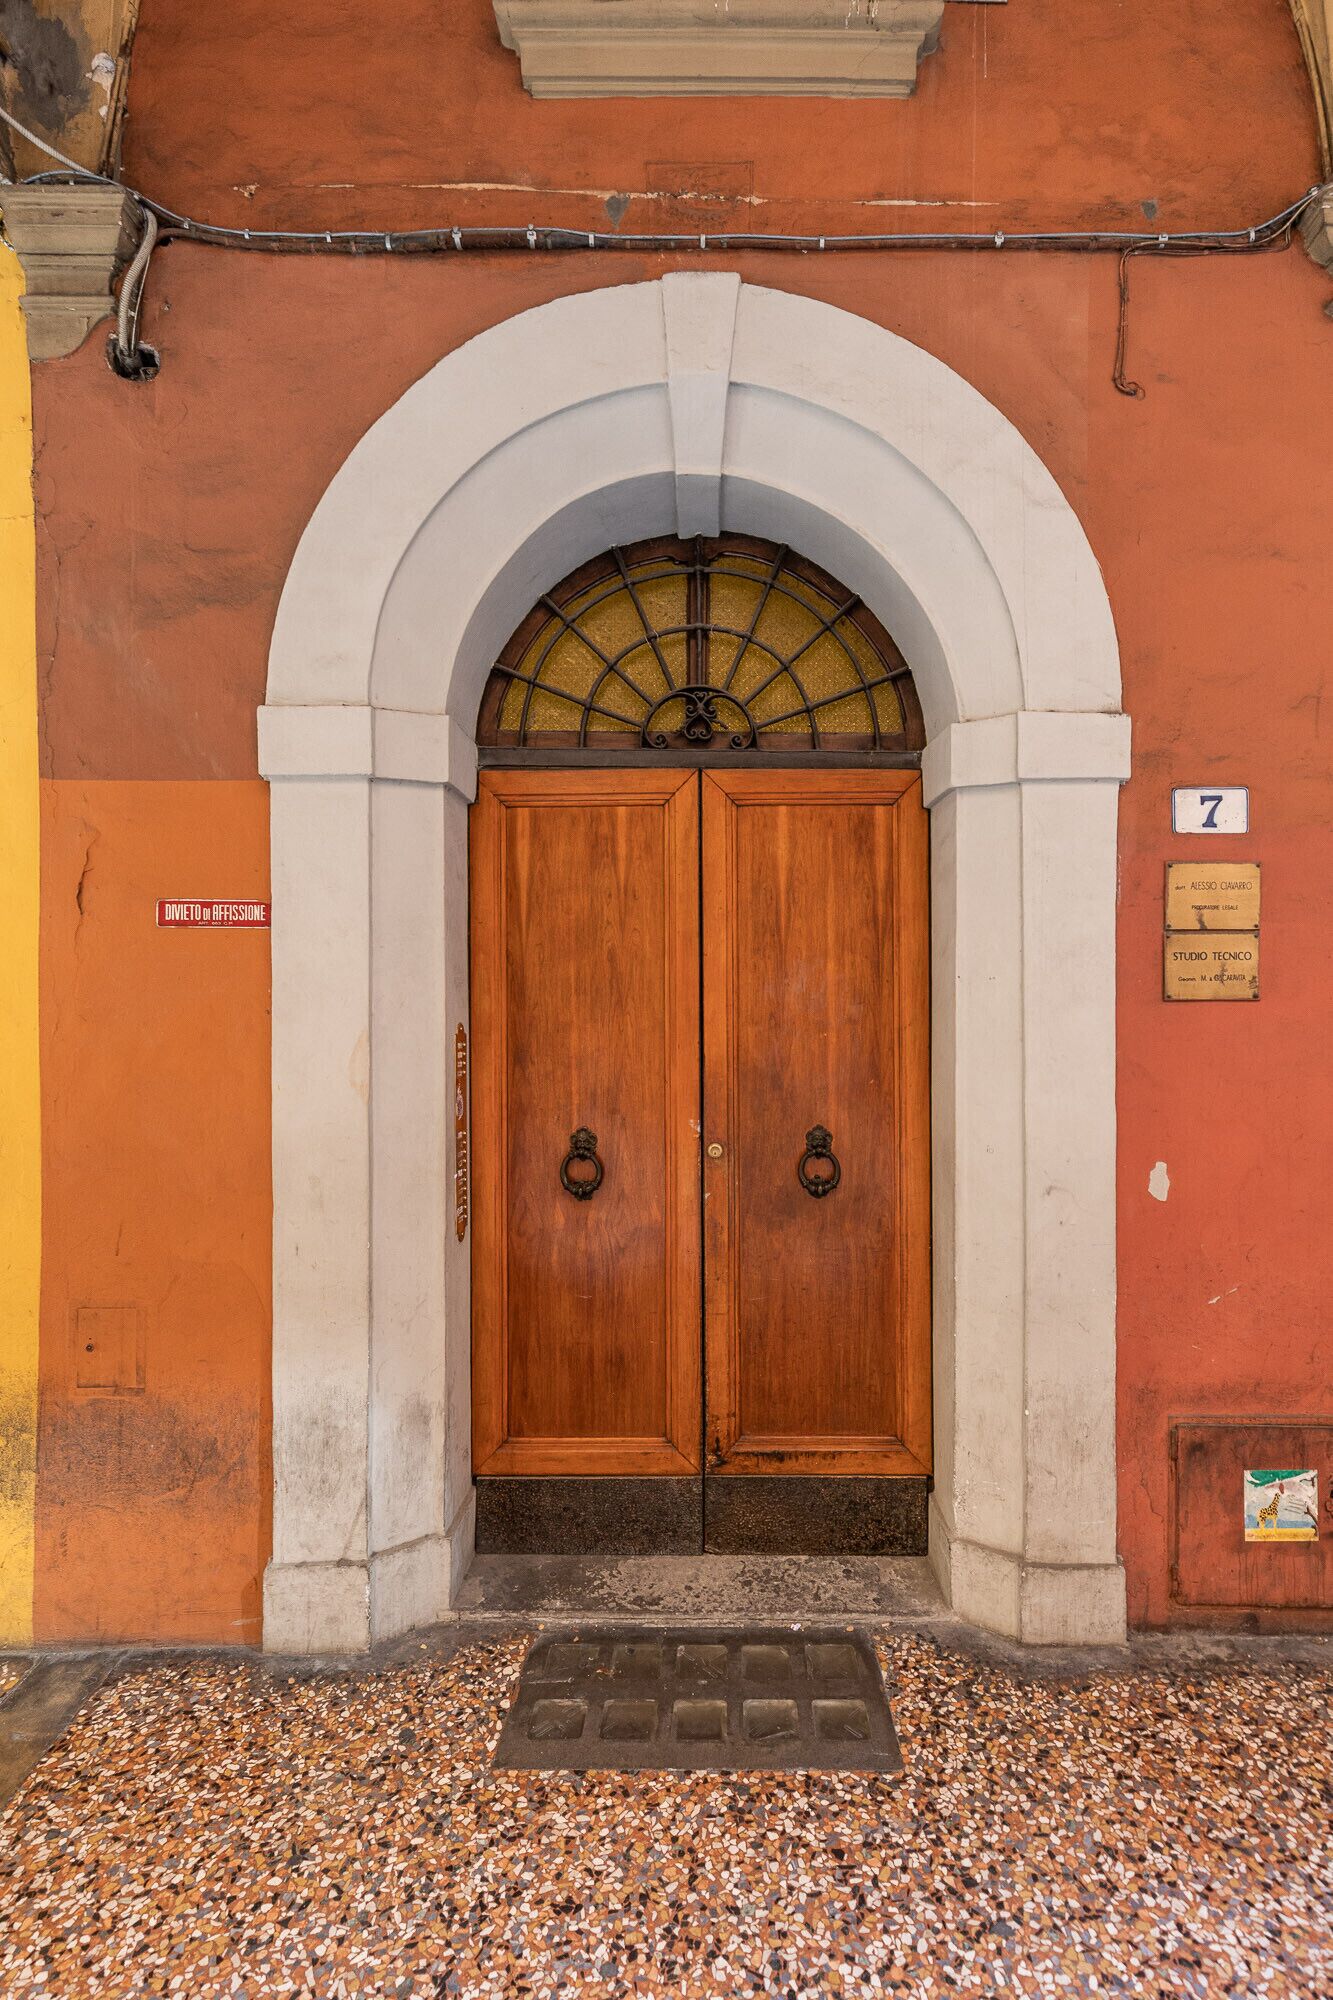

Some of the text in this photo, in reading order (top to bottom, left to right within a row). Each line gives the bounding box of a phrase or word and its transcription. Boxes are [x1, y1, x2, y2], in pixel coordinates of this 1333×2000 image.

[1200, 795, 1223, 828] 7
[1190, 881, 1218, 890] ALESSIO
[1220, 881, 1253, 890] CIAVARRO
[165, 904, 201, 921] DIVIETO
[212, 905, 266, 921] AFFISSIONE
[1173, 951, 1252, 961] STUDIO TECNICO
